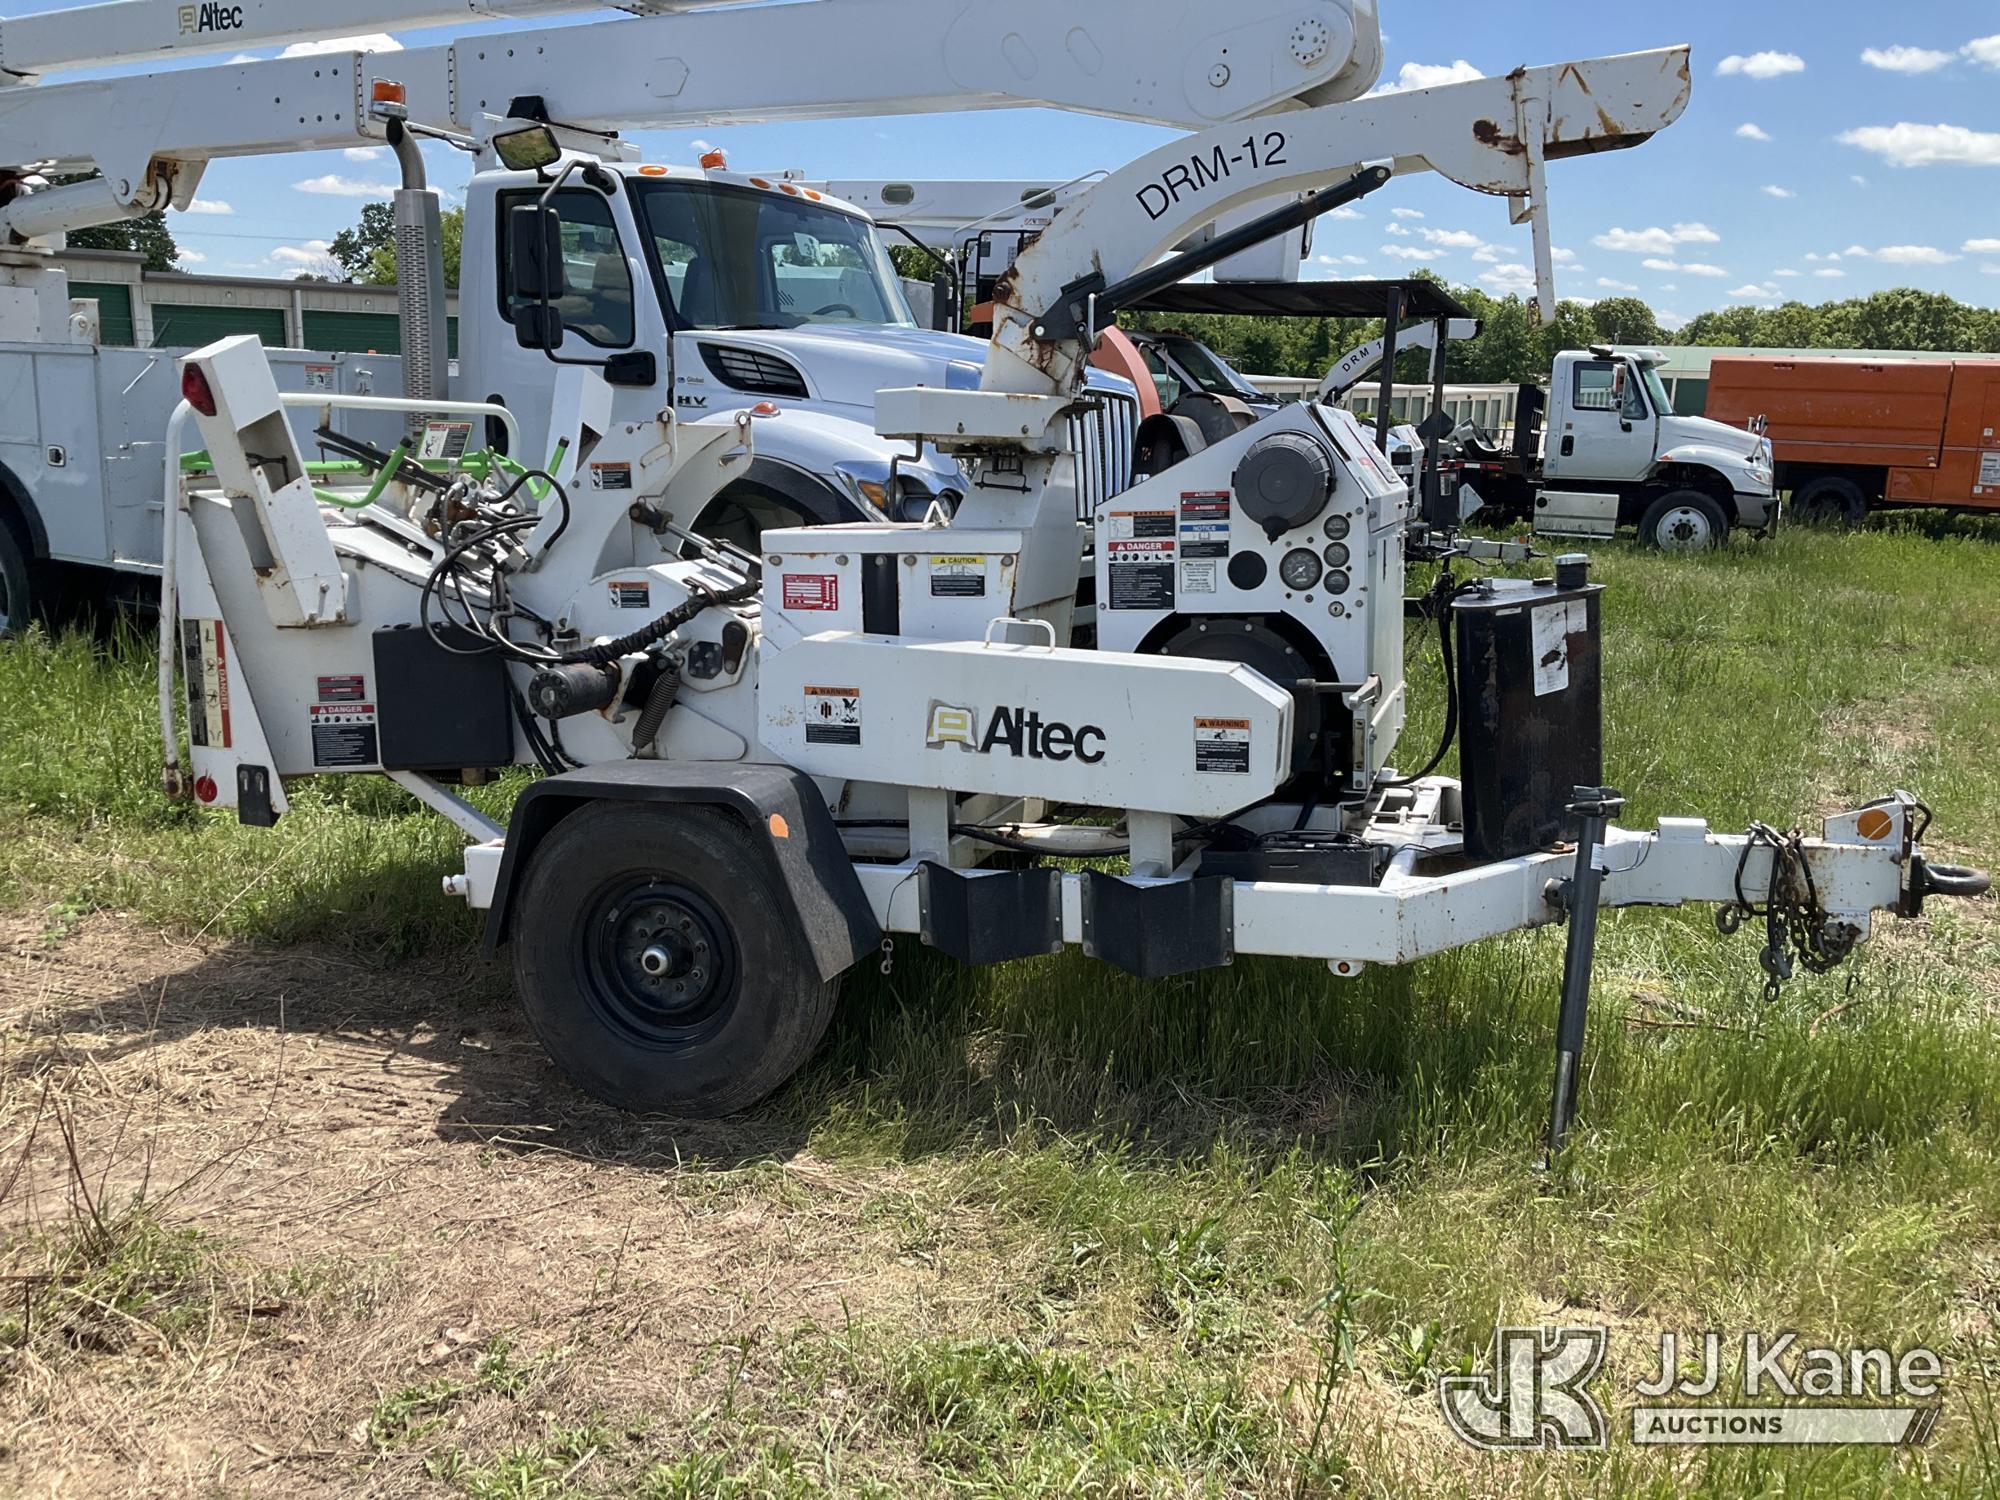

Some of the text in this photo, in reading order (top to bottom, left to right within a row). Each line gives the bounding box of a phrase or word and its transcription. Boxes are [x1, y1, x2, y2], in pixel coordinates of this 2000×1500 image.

[198, 2, 243, 32] Altec
[1135, 131, 1287, 221] DRM-12
[1342, 347, 1370, 372] DRM
[677, 395, 707, 406] HV
[1126, 542, 1162, 551] DANGER
[218, 670, 229, 711] DANGER
[820, 687, 854, 695] WARNING
[978, 705, 1107, 764] Altec
[1208, 719, 1245, 728] WARNING
